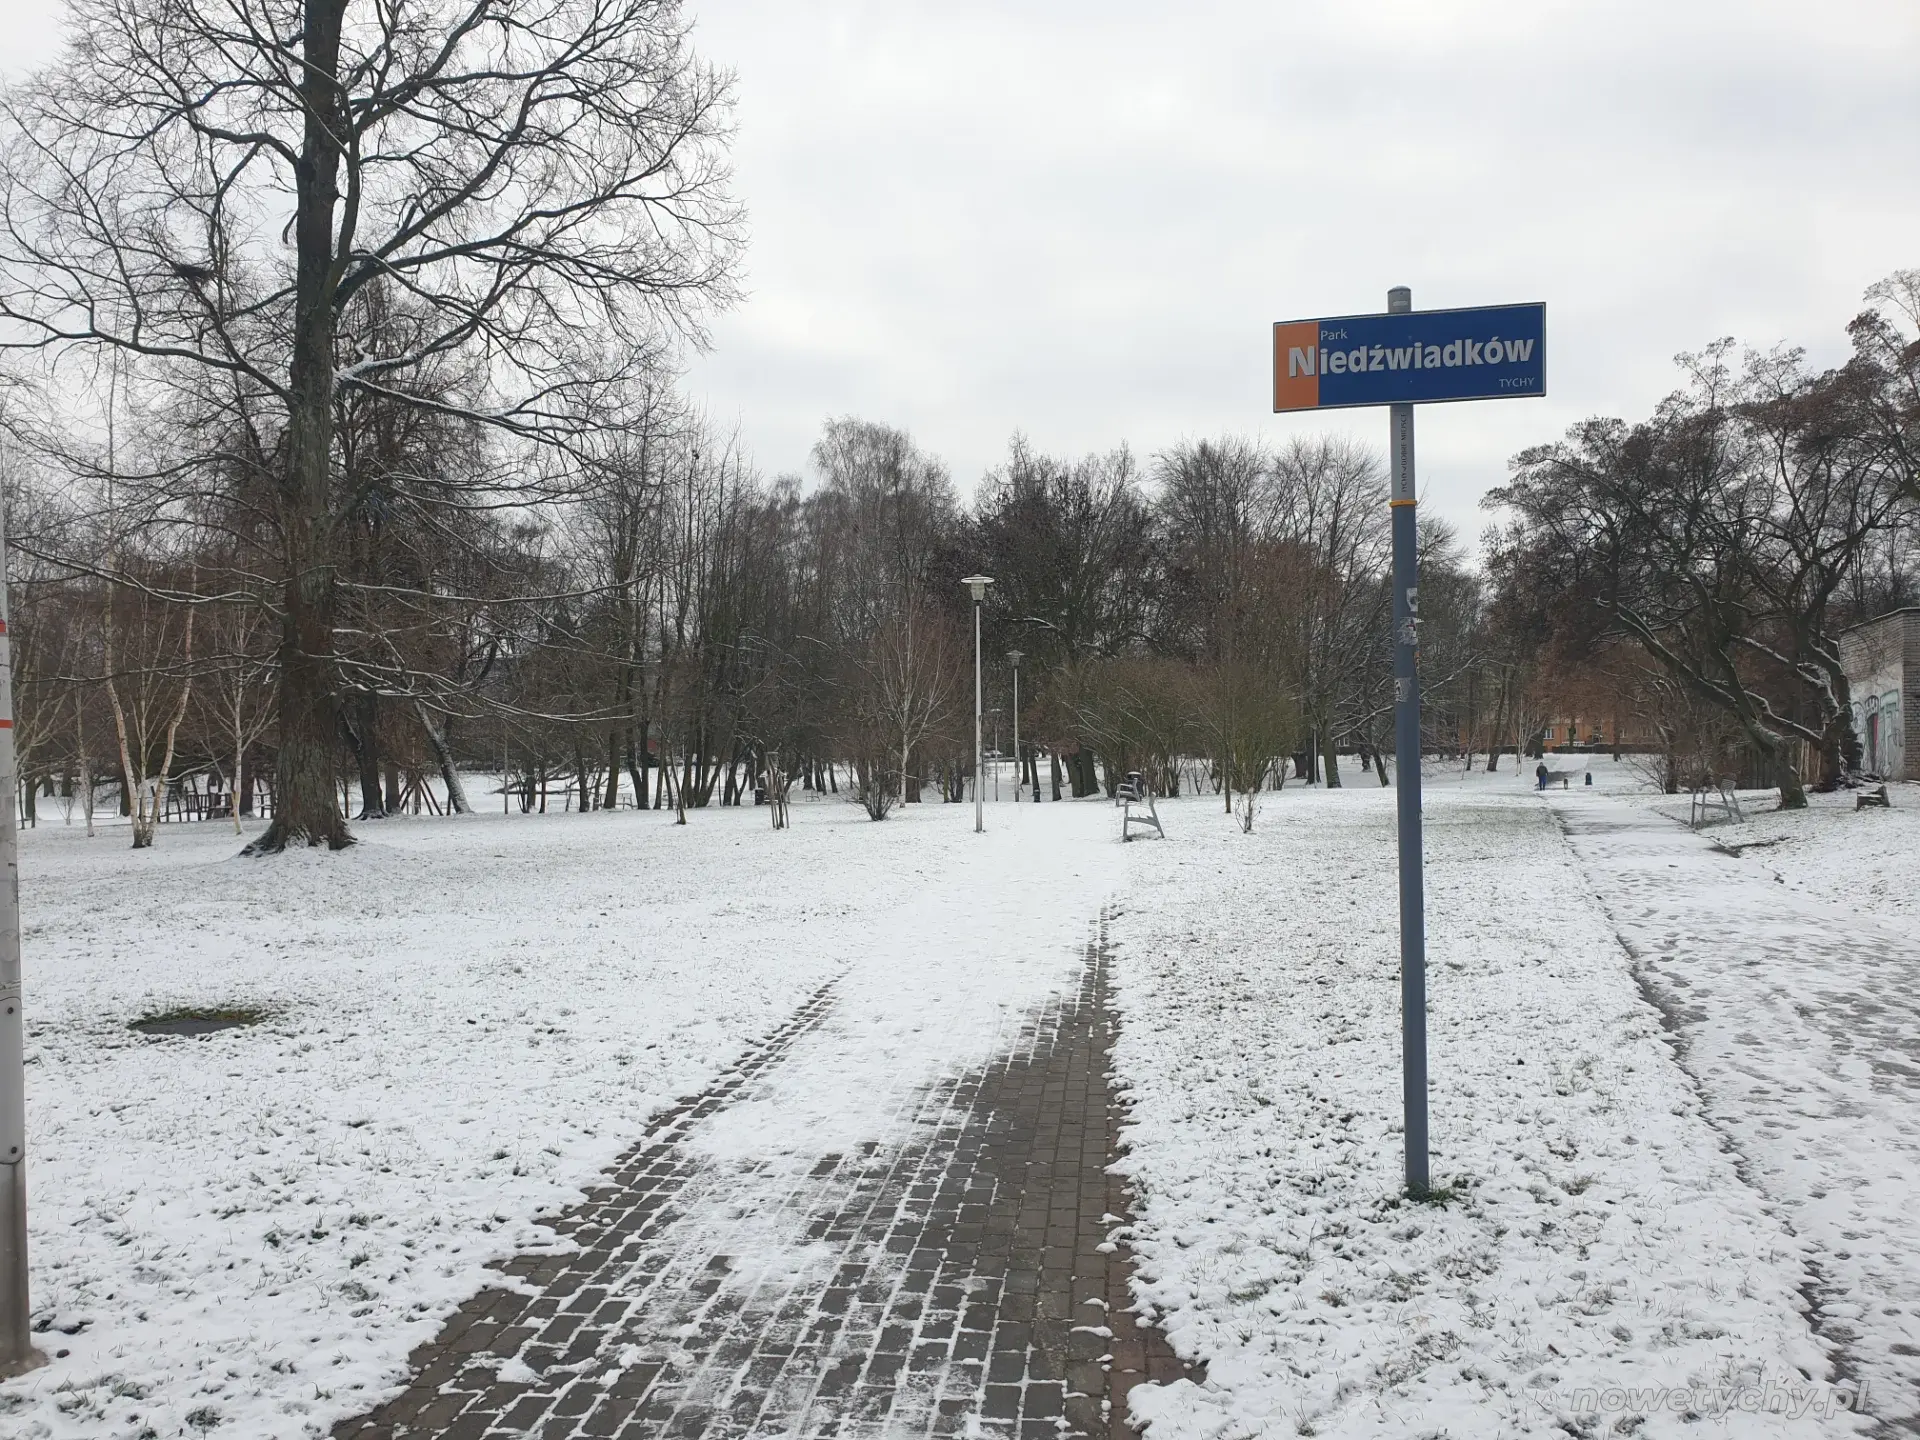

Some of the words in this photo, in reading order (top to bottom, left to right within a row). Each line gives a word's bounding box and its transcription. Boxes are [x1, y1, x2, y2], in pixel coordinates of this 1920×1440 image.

[1320, 329, 1348, 341] Park
[1288, 336, 1534, 378] Niedźwiadków
[1499, 377, 1535, 388] TYCHY
